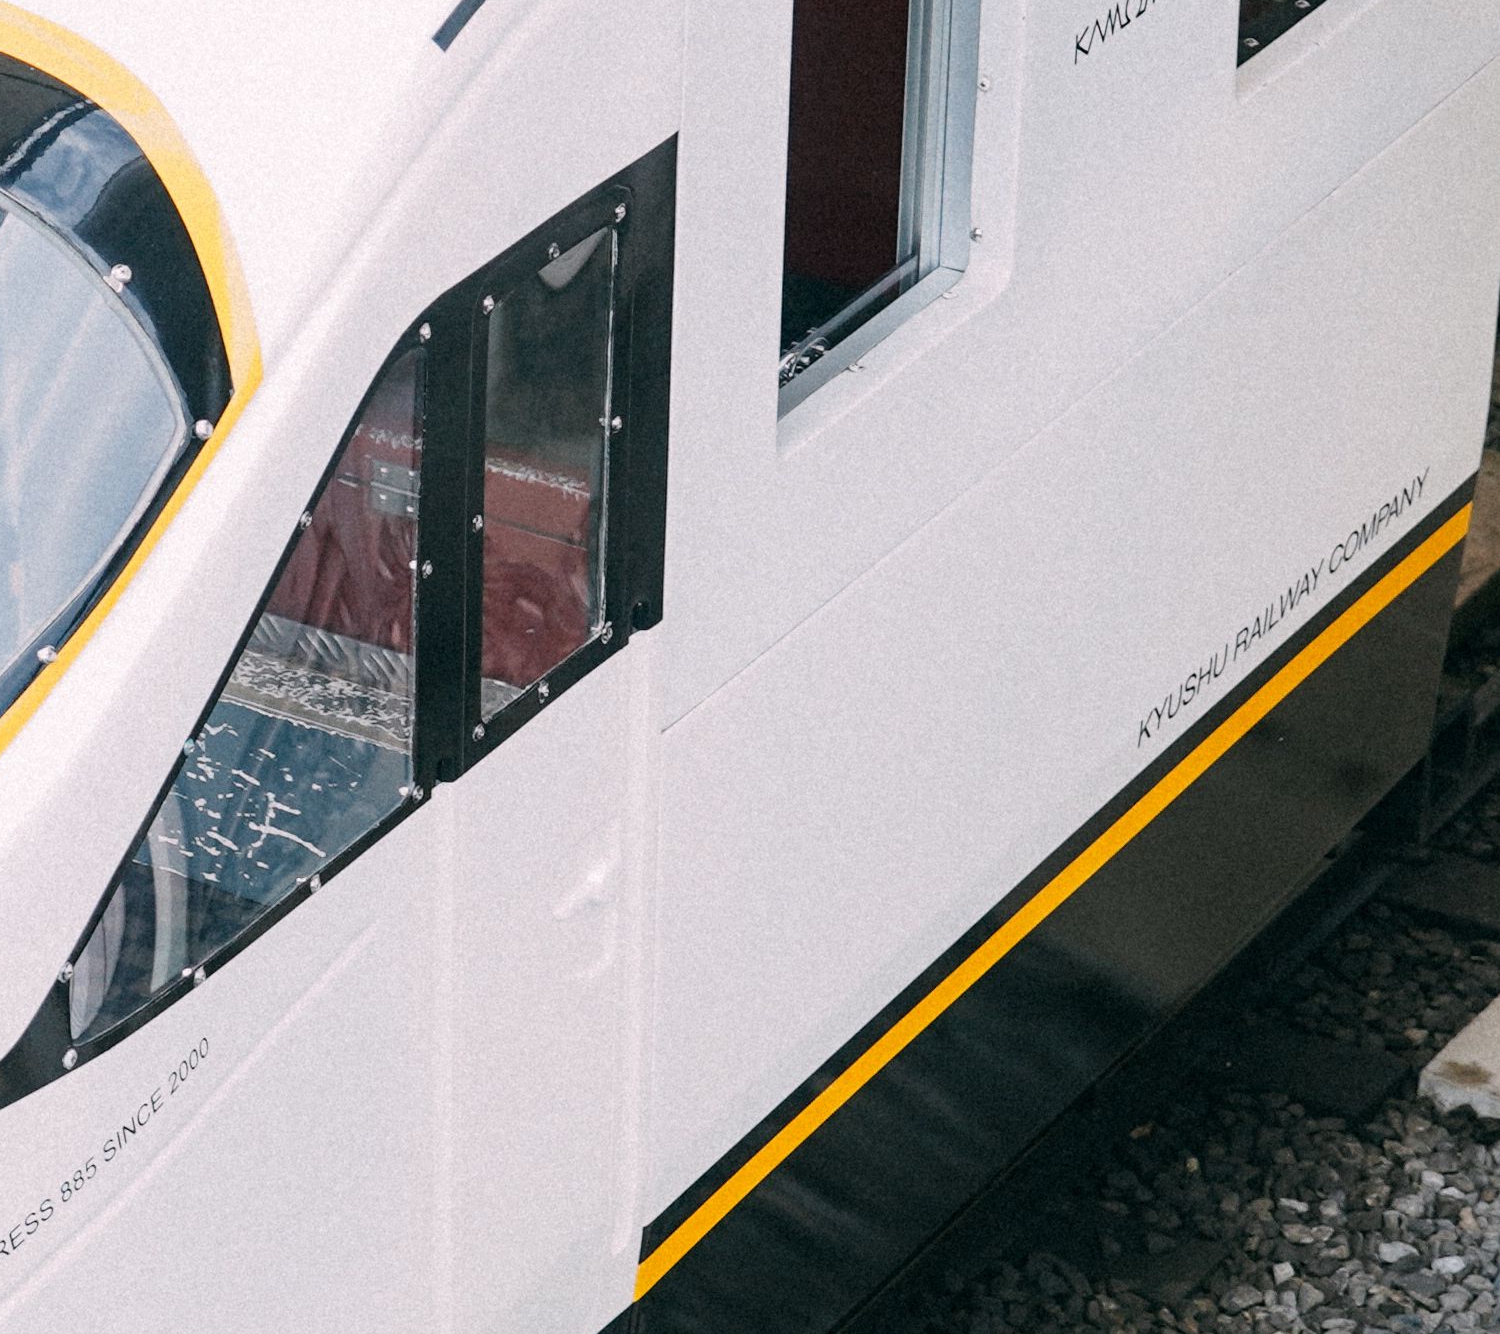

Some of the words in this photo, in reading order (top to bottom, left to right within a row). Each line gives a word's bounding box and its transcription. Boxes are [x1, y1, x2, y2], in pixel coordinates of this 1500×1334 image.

[1137, 643, 1228, 748] KYUSHU
[1233, 558, 1325, 662] RAILWAY
[1328, 466, 1431, 574] COMPANY
[60, 1156, 98, 1203] 885
[102, 1087, 165, 1163] SINCE
[167, 1037, 210, 1096] 2000
